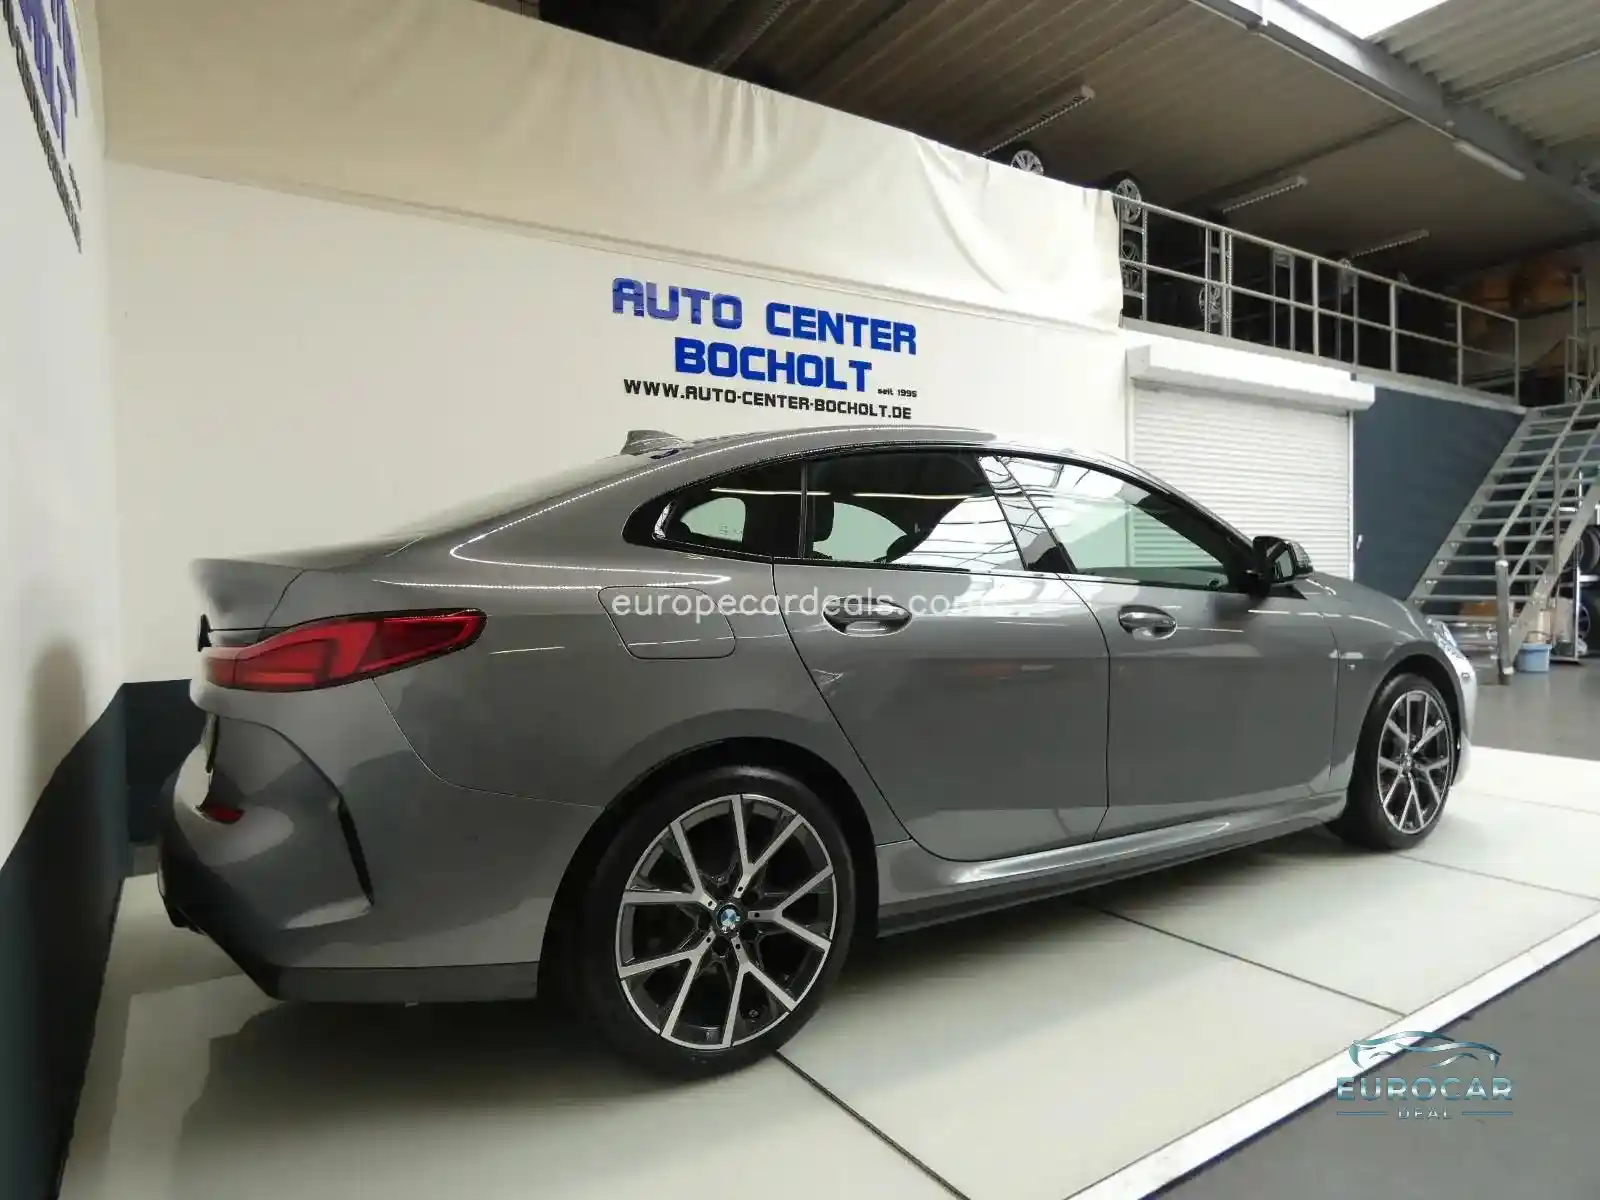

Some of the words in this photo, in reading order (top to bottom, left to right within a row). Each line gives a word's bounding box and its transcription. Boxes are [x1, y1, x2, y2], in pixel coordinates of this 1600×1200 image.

[612, 277, 743, 330] AUTO
[765, 301, 917, 355] CENTER
[674, 336, 872, 392] BOCHOLT
[623, 378, 912, 420] WWW.AUTO-CENTER-BOCHOLT.DE
[877, 388, 894, 396] seit
